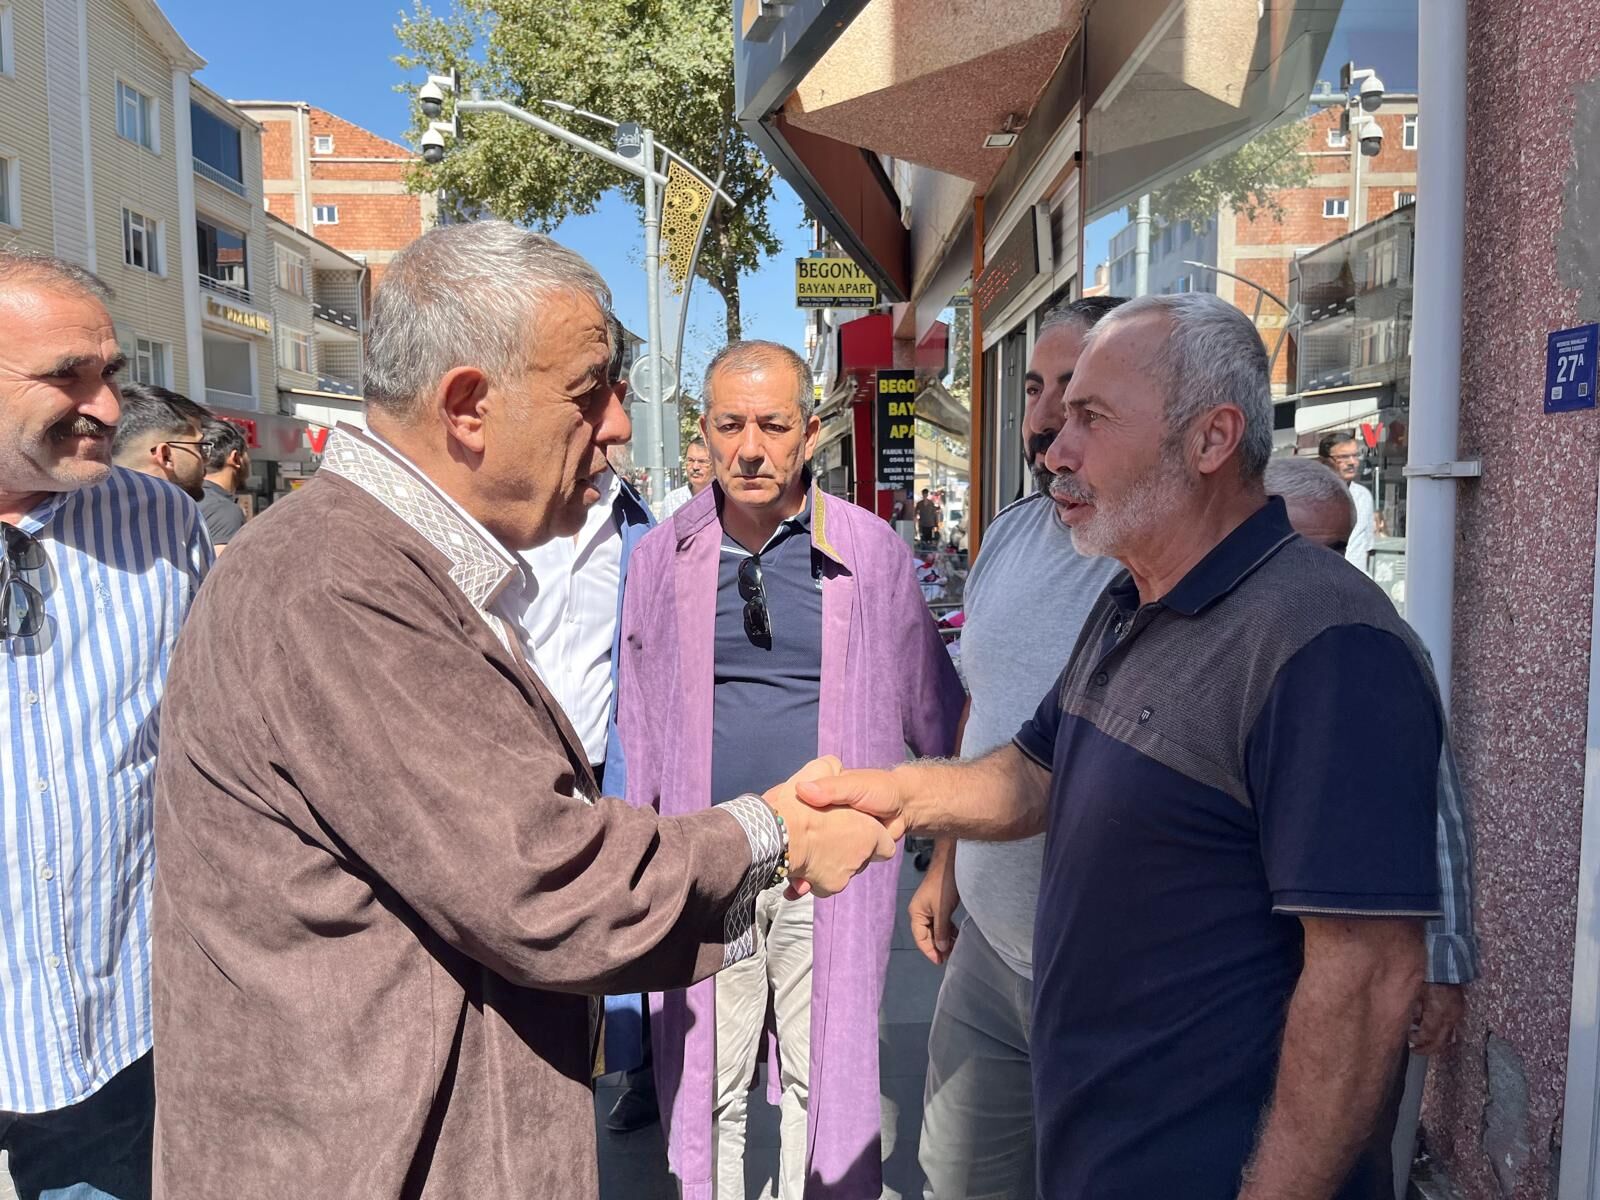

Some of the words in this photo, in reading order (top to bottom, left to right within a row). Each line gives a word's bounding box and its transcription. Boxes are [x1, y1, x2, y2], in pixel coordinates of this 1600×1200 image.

[799, 262, 867, 279] BEGONY
[799, 283, 835, 294] BAYAN
[838, 283, 873, 294] APART
